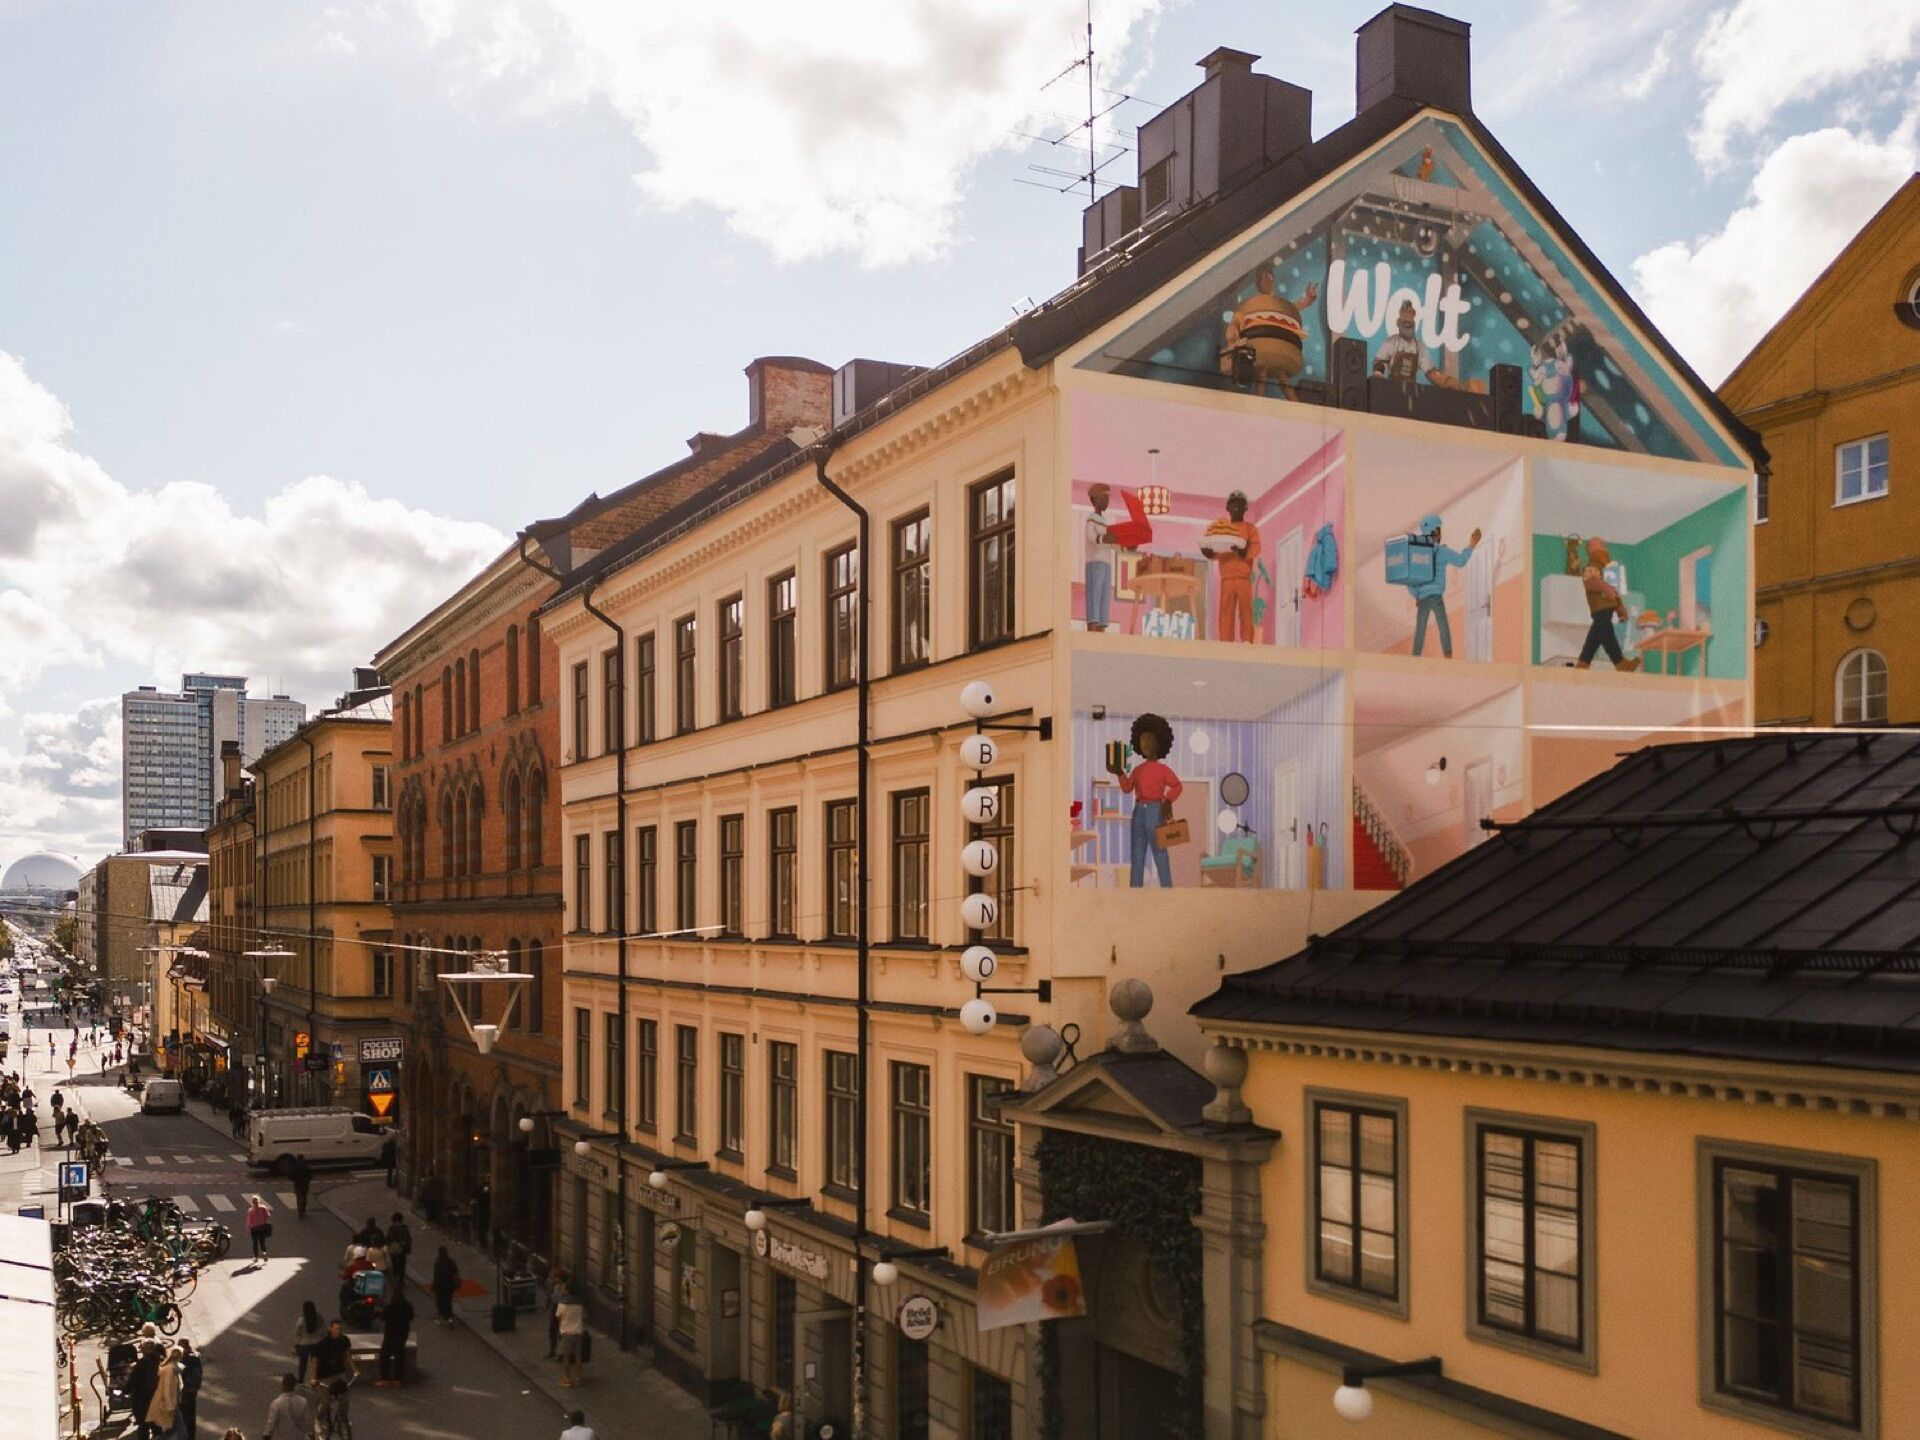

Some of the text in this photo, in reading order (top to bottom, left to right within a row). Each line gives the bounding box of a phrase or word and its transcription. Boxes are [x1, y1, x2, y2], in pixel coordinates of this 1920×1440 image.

[1327, 259, 1471, 352] Wolt
[363, 1040, 400, 1049] POCKET
[362, 1048, 400, 1060] SHOP
